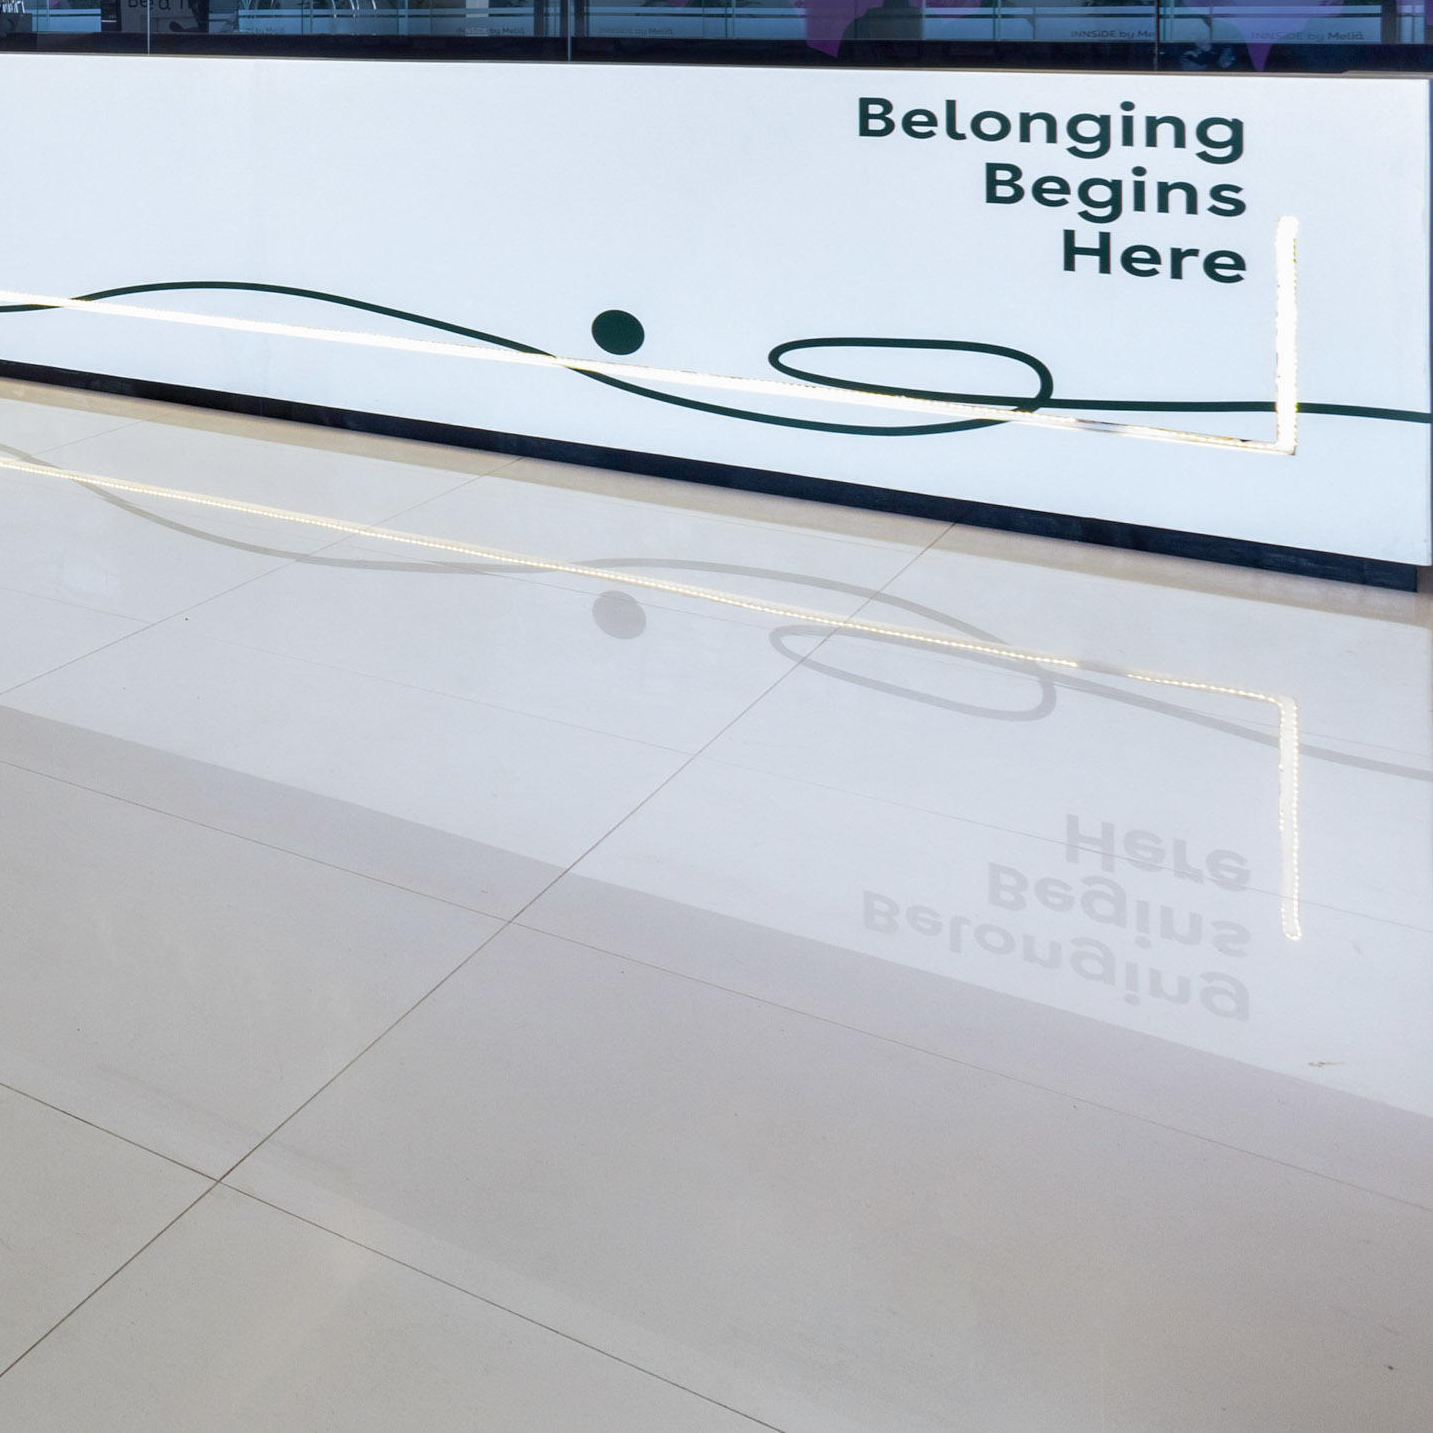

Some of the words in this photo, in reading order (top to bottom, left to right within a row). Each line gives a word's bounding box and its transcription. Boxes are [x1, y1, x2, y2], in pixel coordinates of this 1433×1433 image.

[858, 97, 1245, 164] Belonging
[985, 162, 1246, 223] Begins
[1062, 229, 1246, 283] Here
